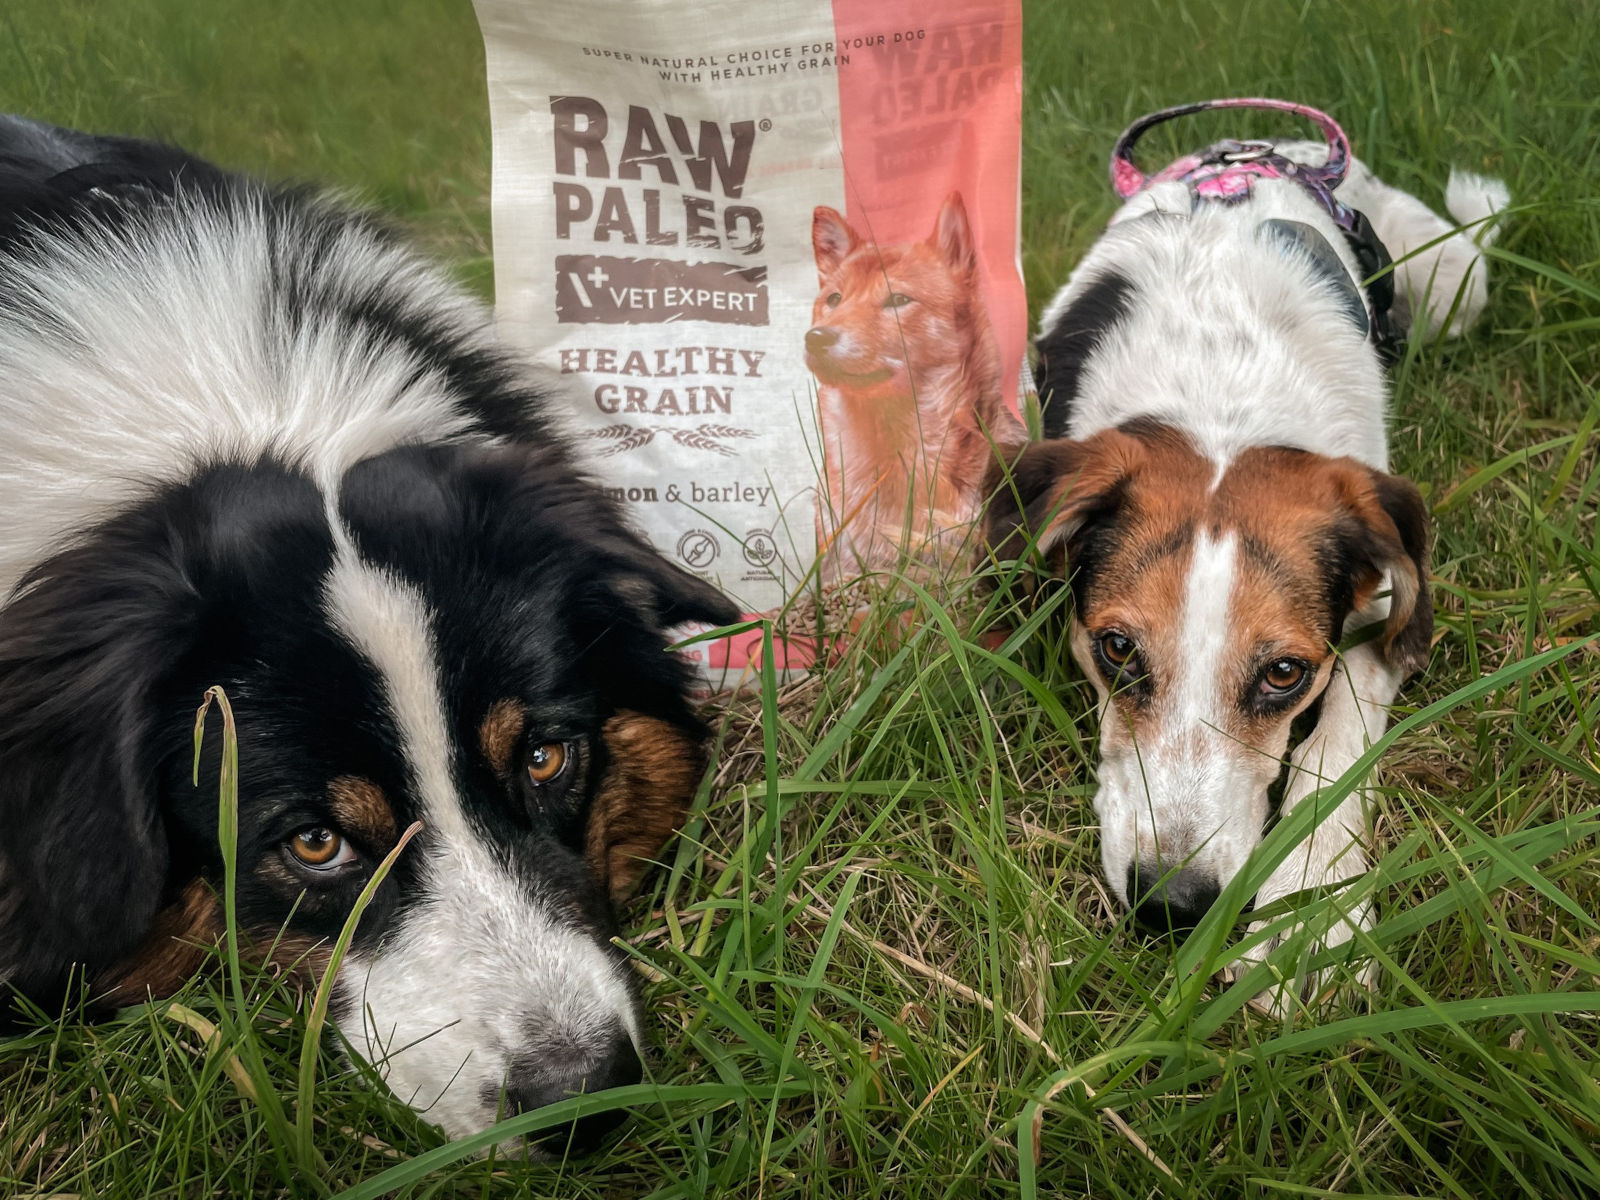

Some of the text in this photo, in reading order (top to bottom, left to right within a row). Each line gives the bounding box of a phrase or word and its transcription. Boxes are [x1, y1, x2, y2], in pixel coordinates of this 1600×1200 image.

[582, 29, 926, 69] SUPER NATURAL CHOICE FOR YOUR DOG
[658, 70, 702, 83] WITH
[711, 62, 789, 81] HEALTHY
[797, 55, 851, 70] GRAIN
[549, 95, 756, 200] RAW
[552, 181, 766, 256] PALEO
[609, 287, 759, 312] VET EXPERT
[558, 346, 767, 378] HEALTHY
[594, 383, 735, 416] GRAIN
[665, 483, 681, 502] &
[690, 481, 772, 507] barley
